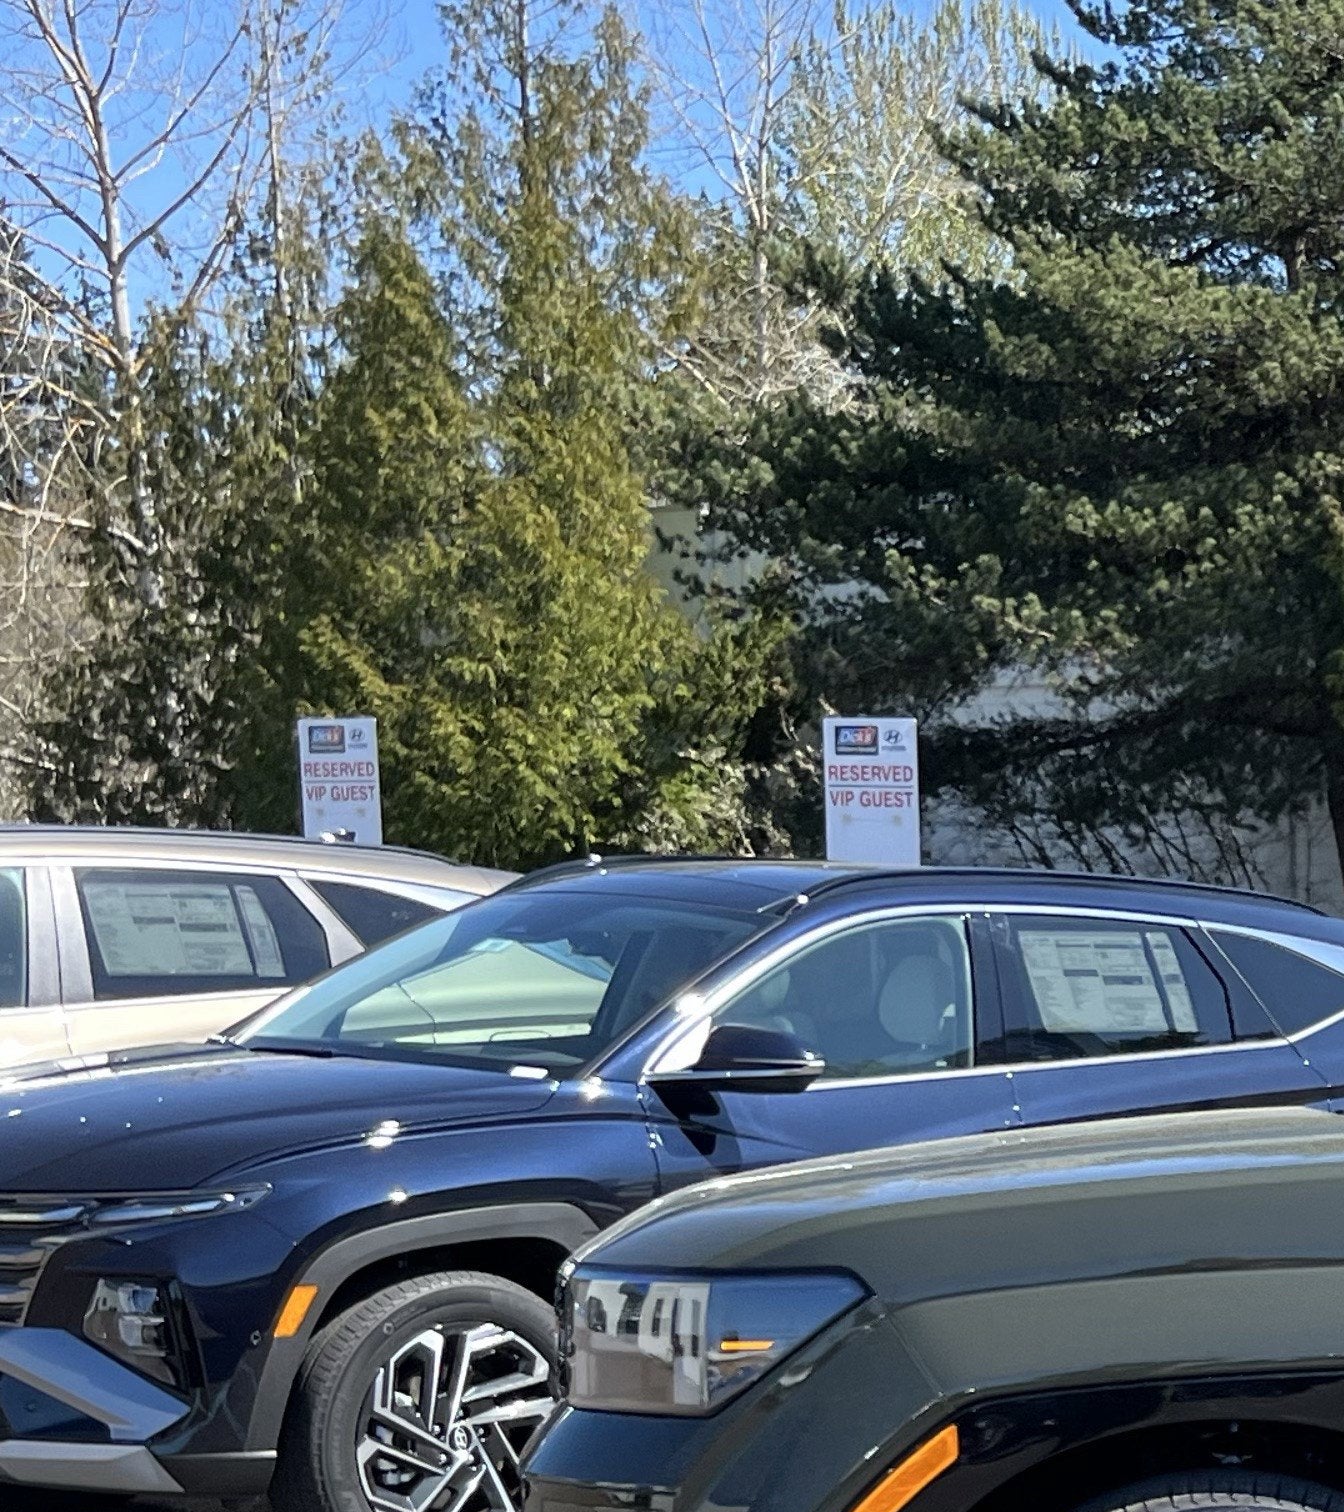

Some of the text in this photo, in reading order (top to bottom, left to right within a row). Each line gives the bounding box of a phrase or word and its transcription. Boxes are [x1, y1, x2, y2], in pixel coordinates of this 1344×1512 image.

[303, 761, 376, 778] RESERVED
[828, 765, 914, 782] RESERVED
[306, 785, 376, 801] VIP GUEST
[830, 790, 913, 808] VIP GUEST
